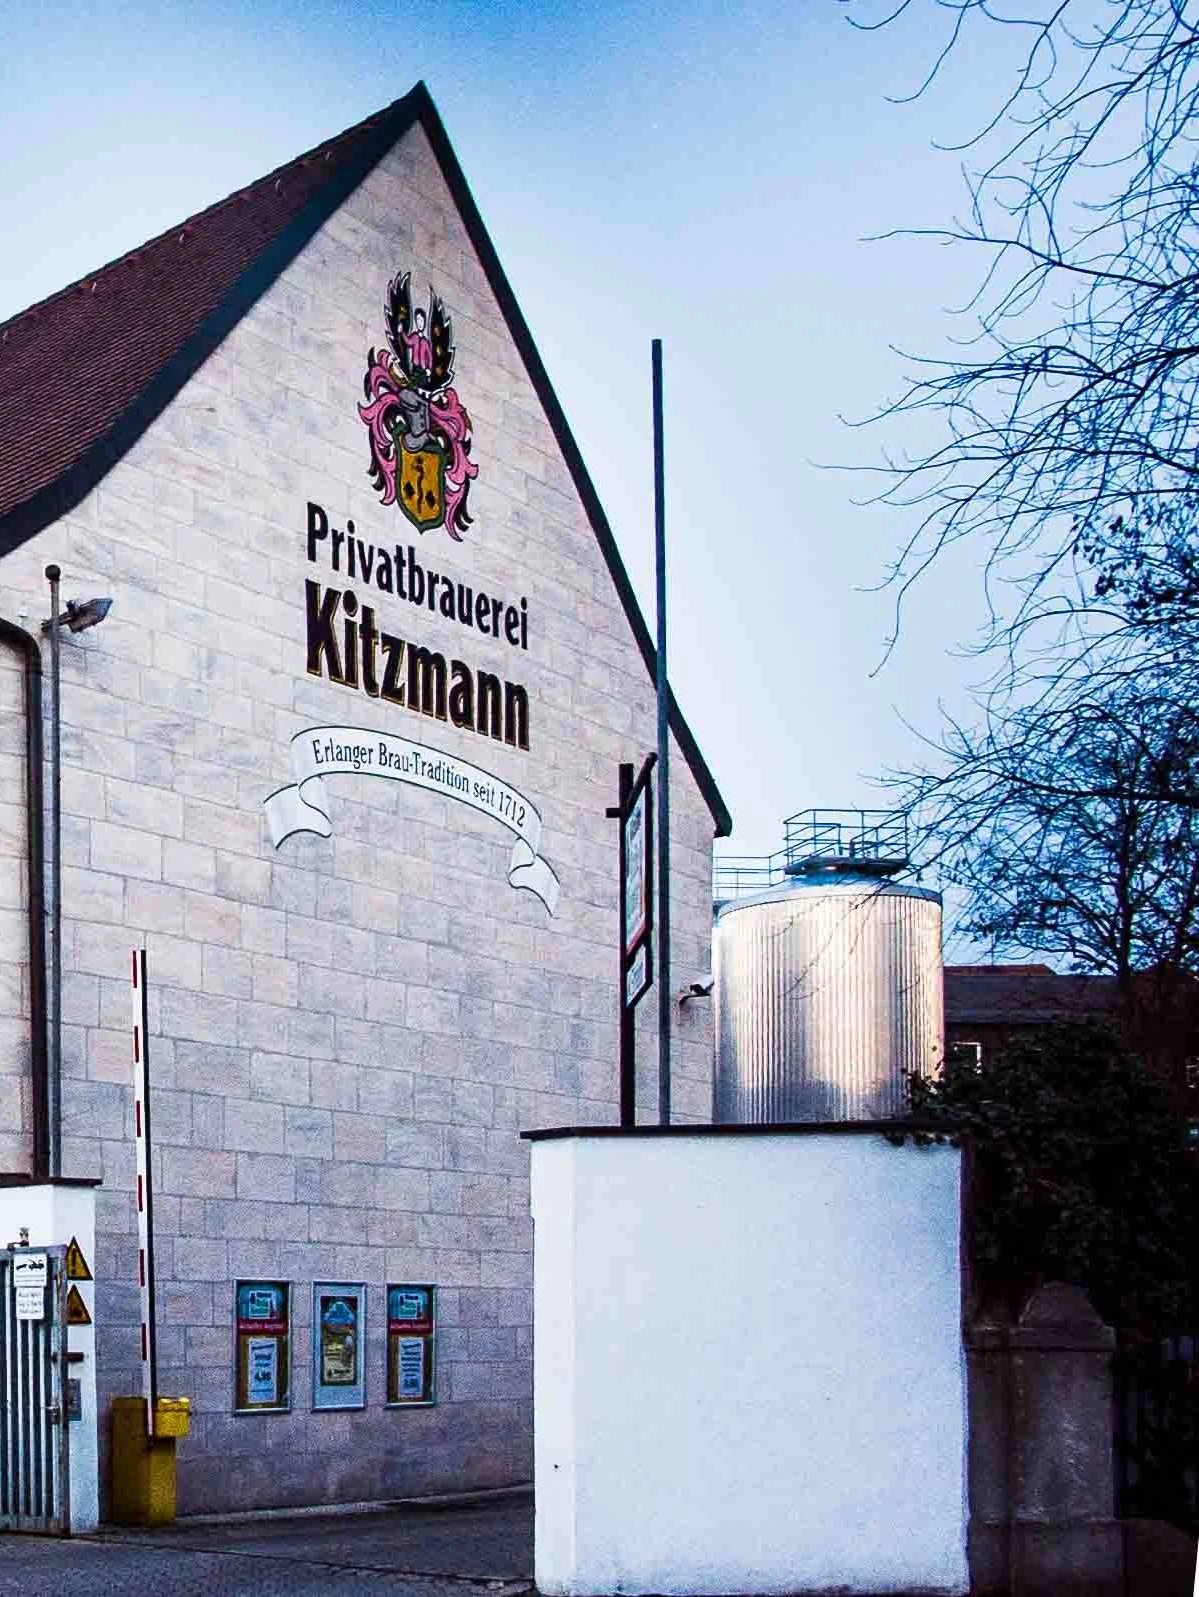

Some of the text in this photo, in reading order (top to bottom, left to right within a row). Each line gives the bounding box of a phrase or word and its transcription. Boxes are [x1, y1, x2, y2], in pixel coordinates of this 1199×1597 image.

[307, 502, 528, 650] Privatbrauerei
[305, 579, 530, 751] Kitzmann
[312, 739, 527, 828] Erlanger Brau-Tradition seit 1712
